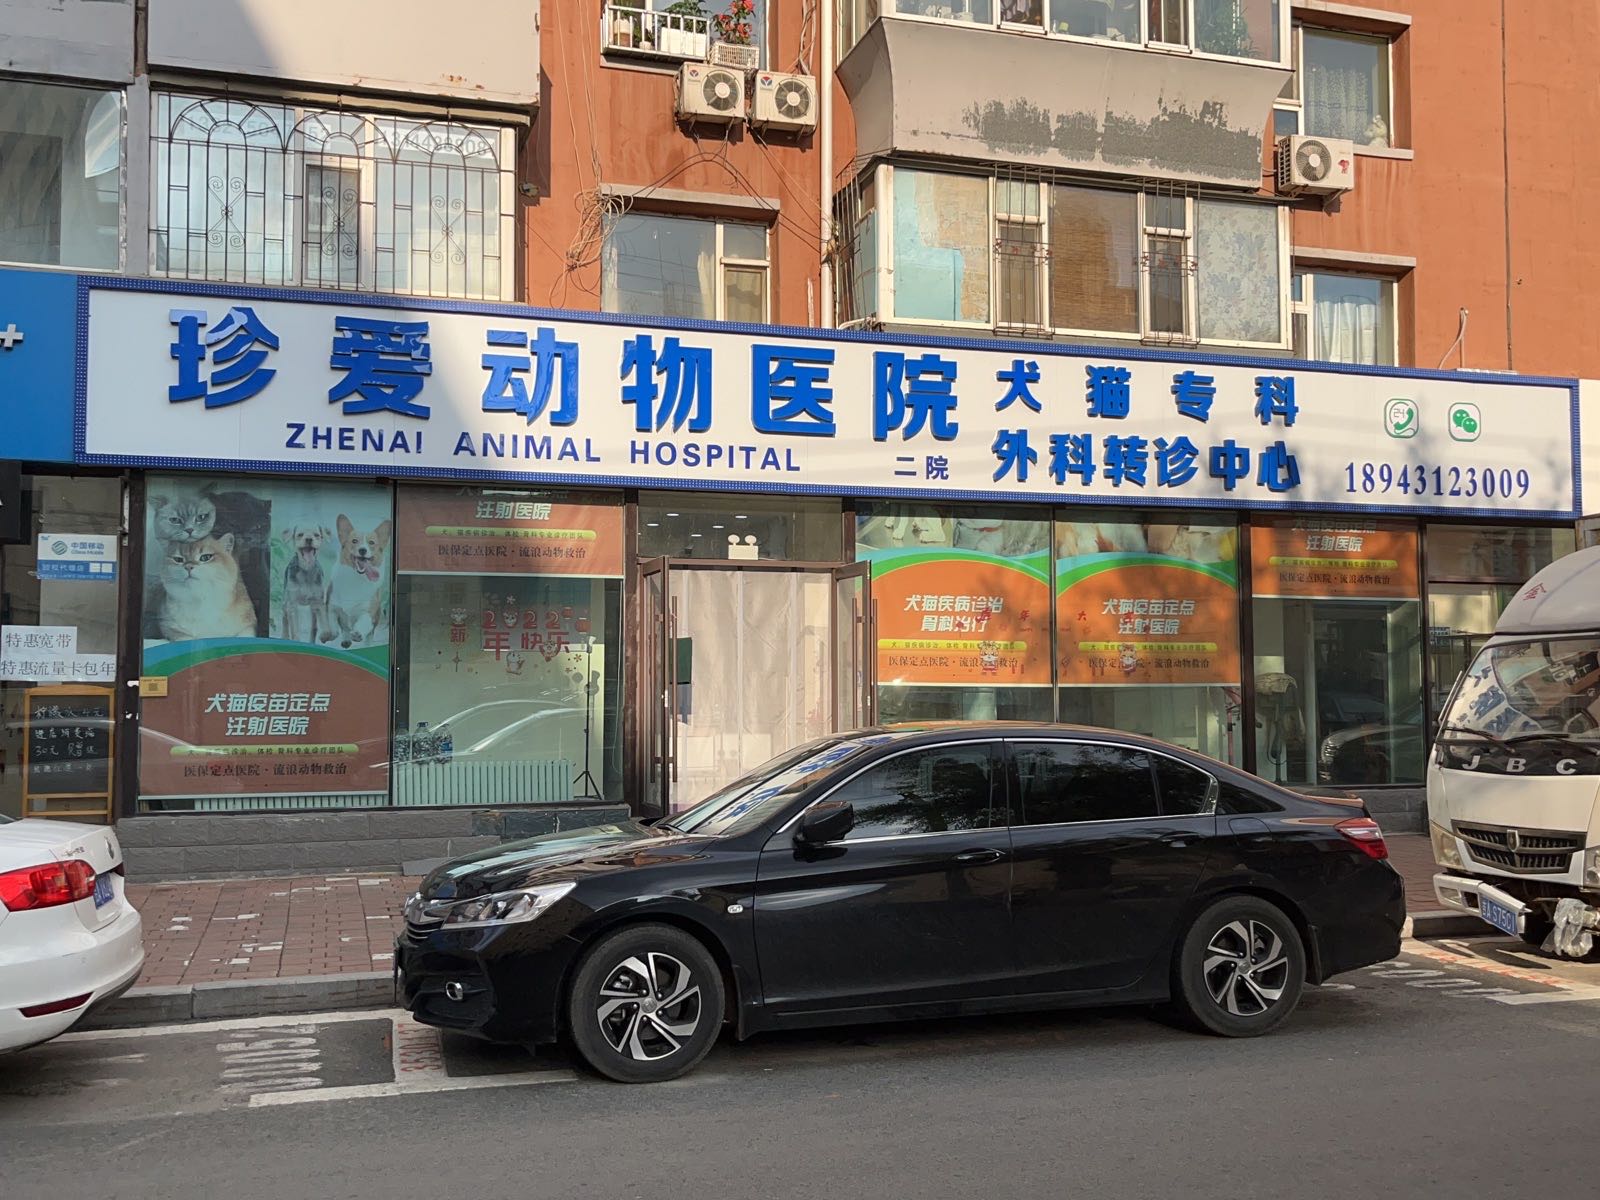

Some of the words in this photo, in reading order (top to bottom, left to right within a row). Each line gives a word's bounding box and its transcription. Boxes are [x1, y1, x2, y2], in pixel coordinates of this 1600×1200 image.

[168, 306, 958, 441] 珍爱动物医院
[995, 359, 1299, 427] 犬猫专科
[286, 422, 422, 454] ZHENAI
[453, 431, 600, 463] ANIMAL
[630, 441, 801, 473] HOSPITAL
[991, 429, 1301, 493] 外科转诊中心
[894, 459, 949, 481] 二院
[1345, 461, 1531, 499] 18943123009
[70, 542, 105, 550] 中国移动
[5, 631, 72, 650] 特惠宽带
[0, 660, 117, 678] 特惠流量卡包年
[205, 692, 331, 713] 犬猫疫苗定点
